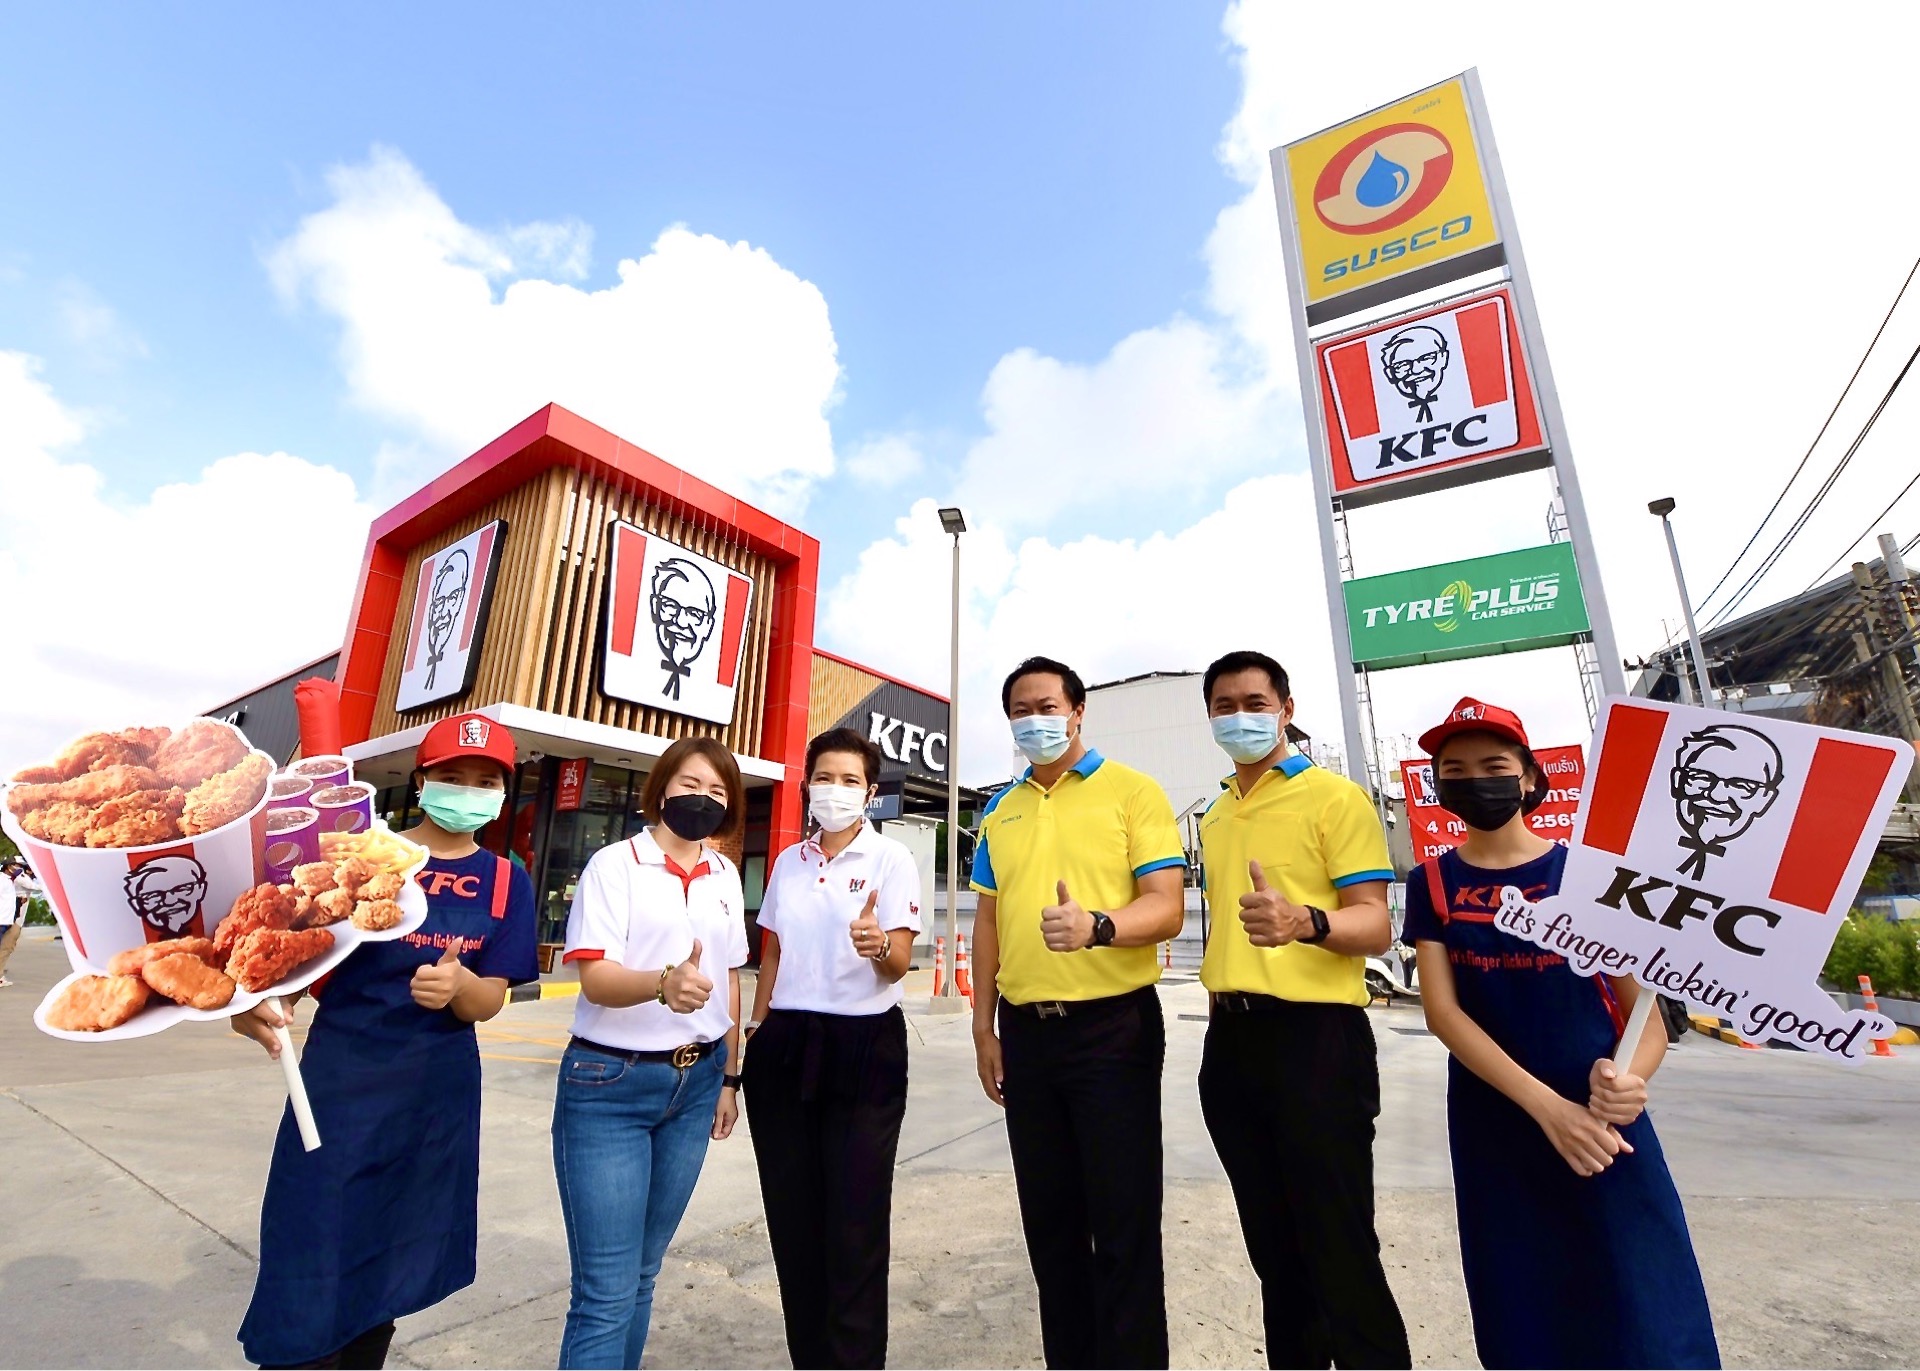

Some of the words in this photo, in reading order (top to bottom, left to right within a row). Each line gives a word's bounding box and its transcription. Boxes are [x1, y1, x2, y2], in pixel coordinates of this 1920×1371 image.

[1323, 215, 1472, 283] SUSCO
[1375, 413, 1488, 470] KFC
[1362, 594, 1457, 628] TYRE
[1468, 579, 1560, 612] PLUS
[1471, 609, 1498, 621] CAR
[1500, 601, 1556, 617] SERVICE
[868, 711, 948, 772] KFC
[1541, 787, 1581, 803] การ
[1426, 820, 1439, 833] 4
[1594, 866, 1782, 957] KFC
[401, 932, 432, 949] inger
[1467, 950, 1500, 972] finger
[1541, 913, 1639, 970] finger
[1641, 947, 1749, 1014] lickin'
